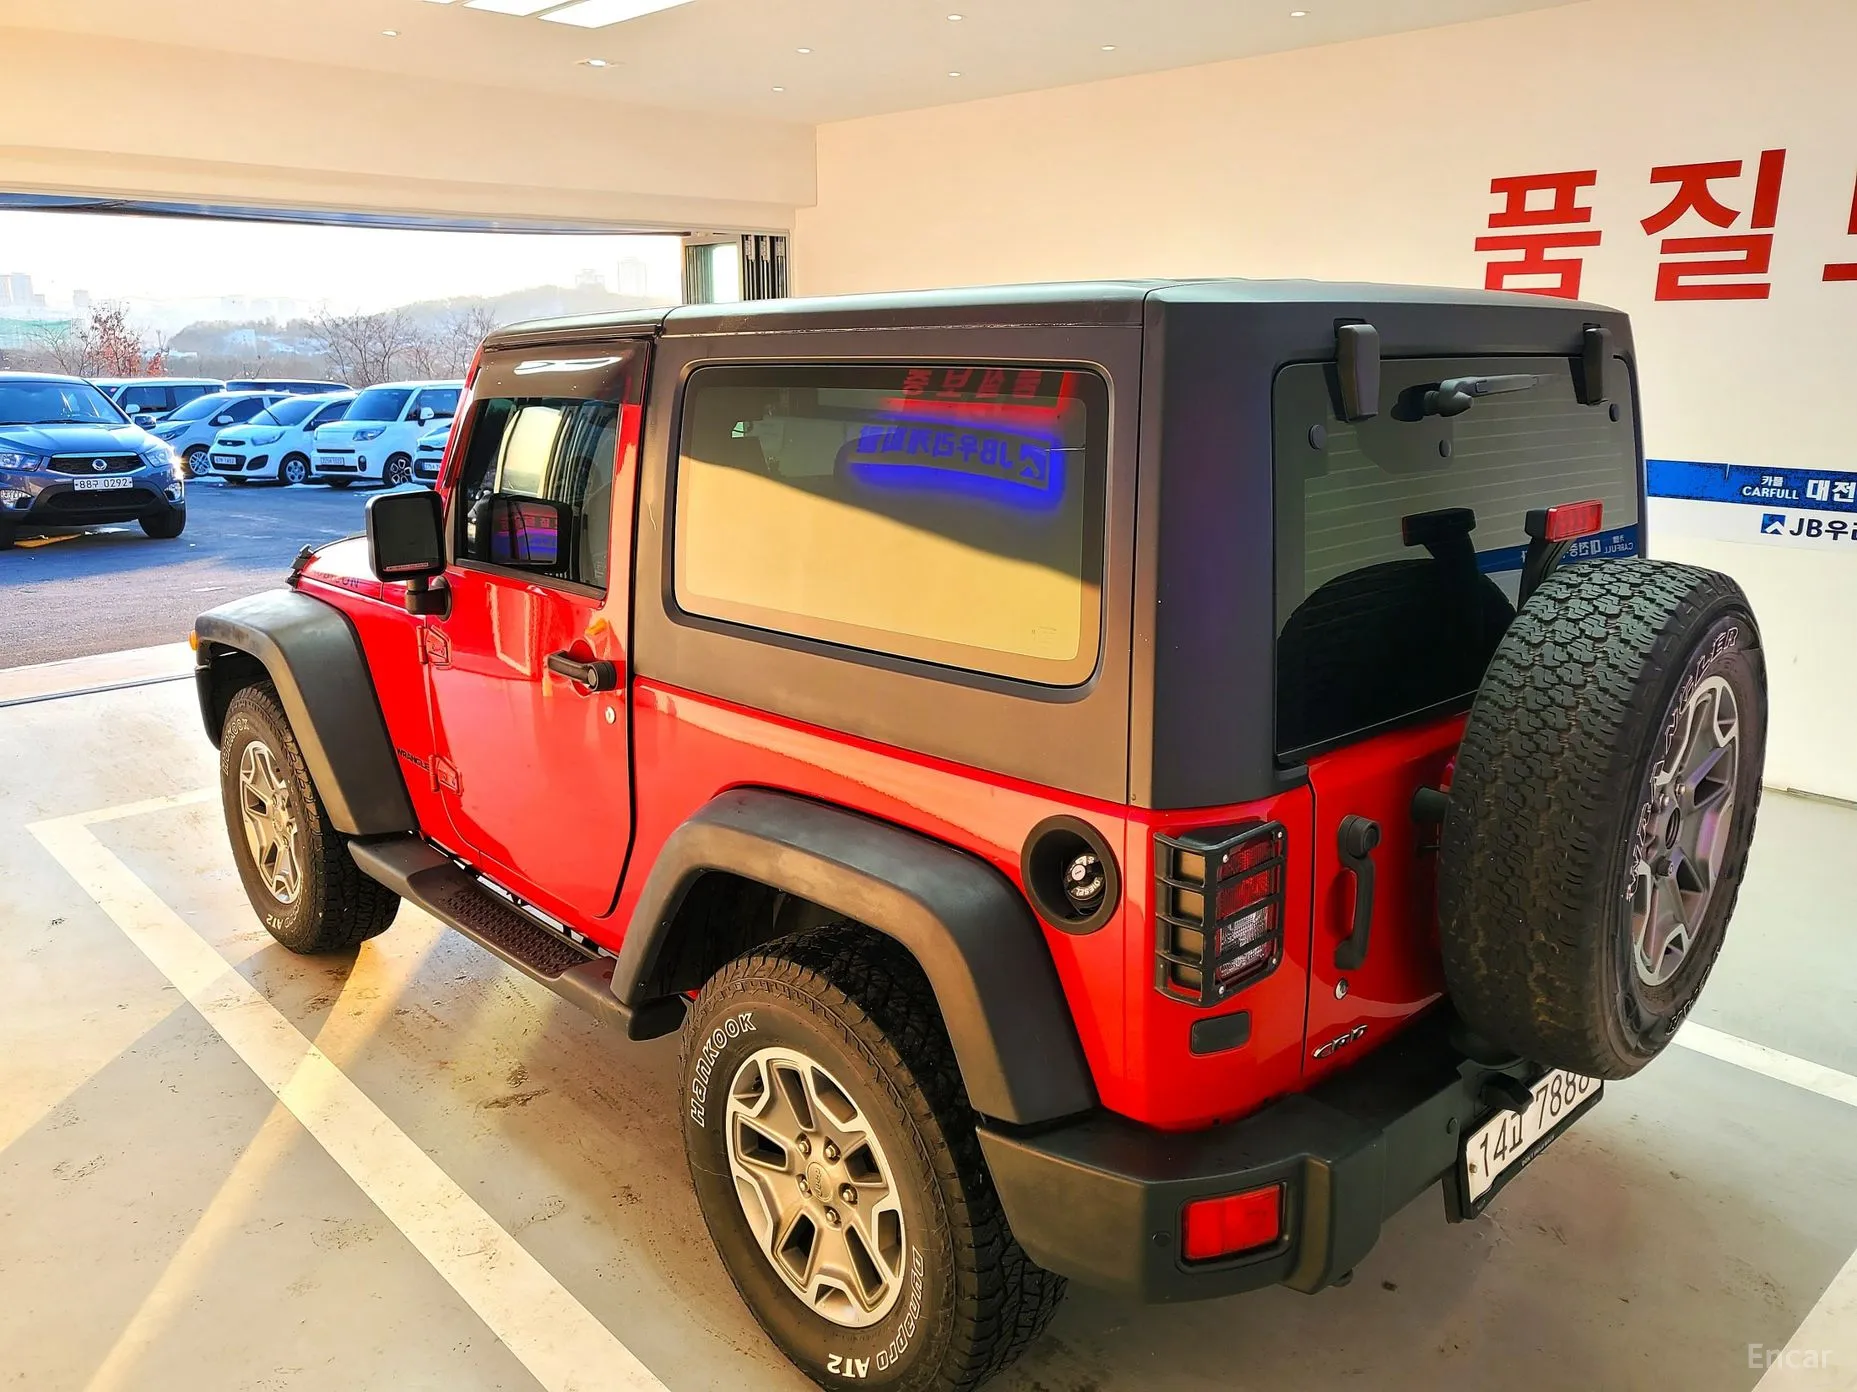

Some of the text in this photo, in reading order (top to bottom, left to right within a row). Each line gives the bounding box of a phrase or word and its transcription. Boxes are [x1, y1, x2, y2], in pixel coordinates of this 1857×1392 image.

[1474, 148, 1857, 300] 품질
[103, 478, 129, 488] 0292
[1742, 486, 1799, 500] CARFULL
[827, 1352, 872, 1379] AT2
